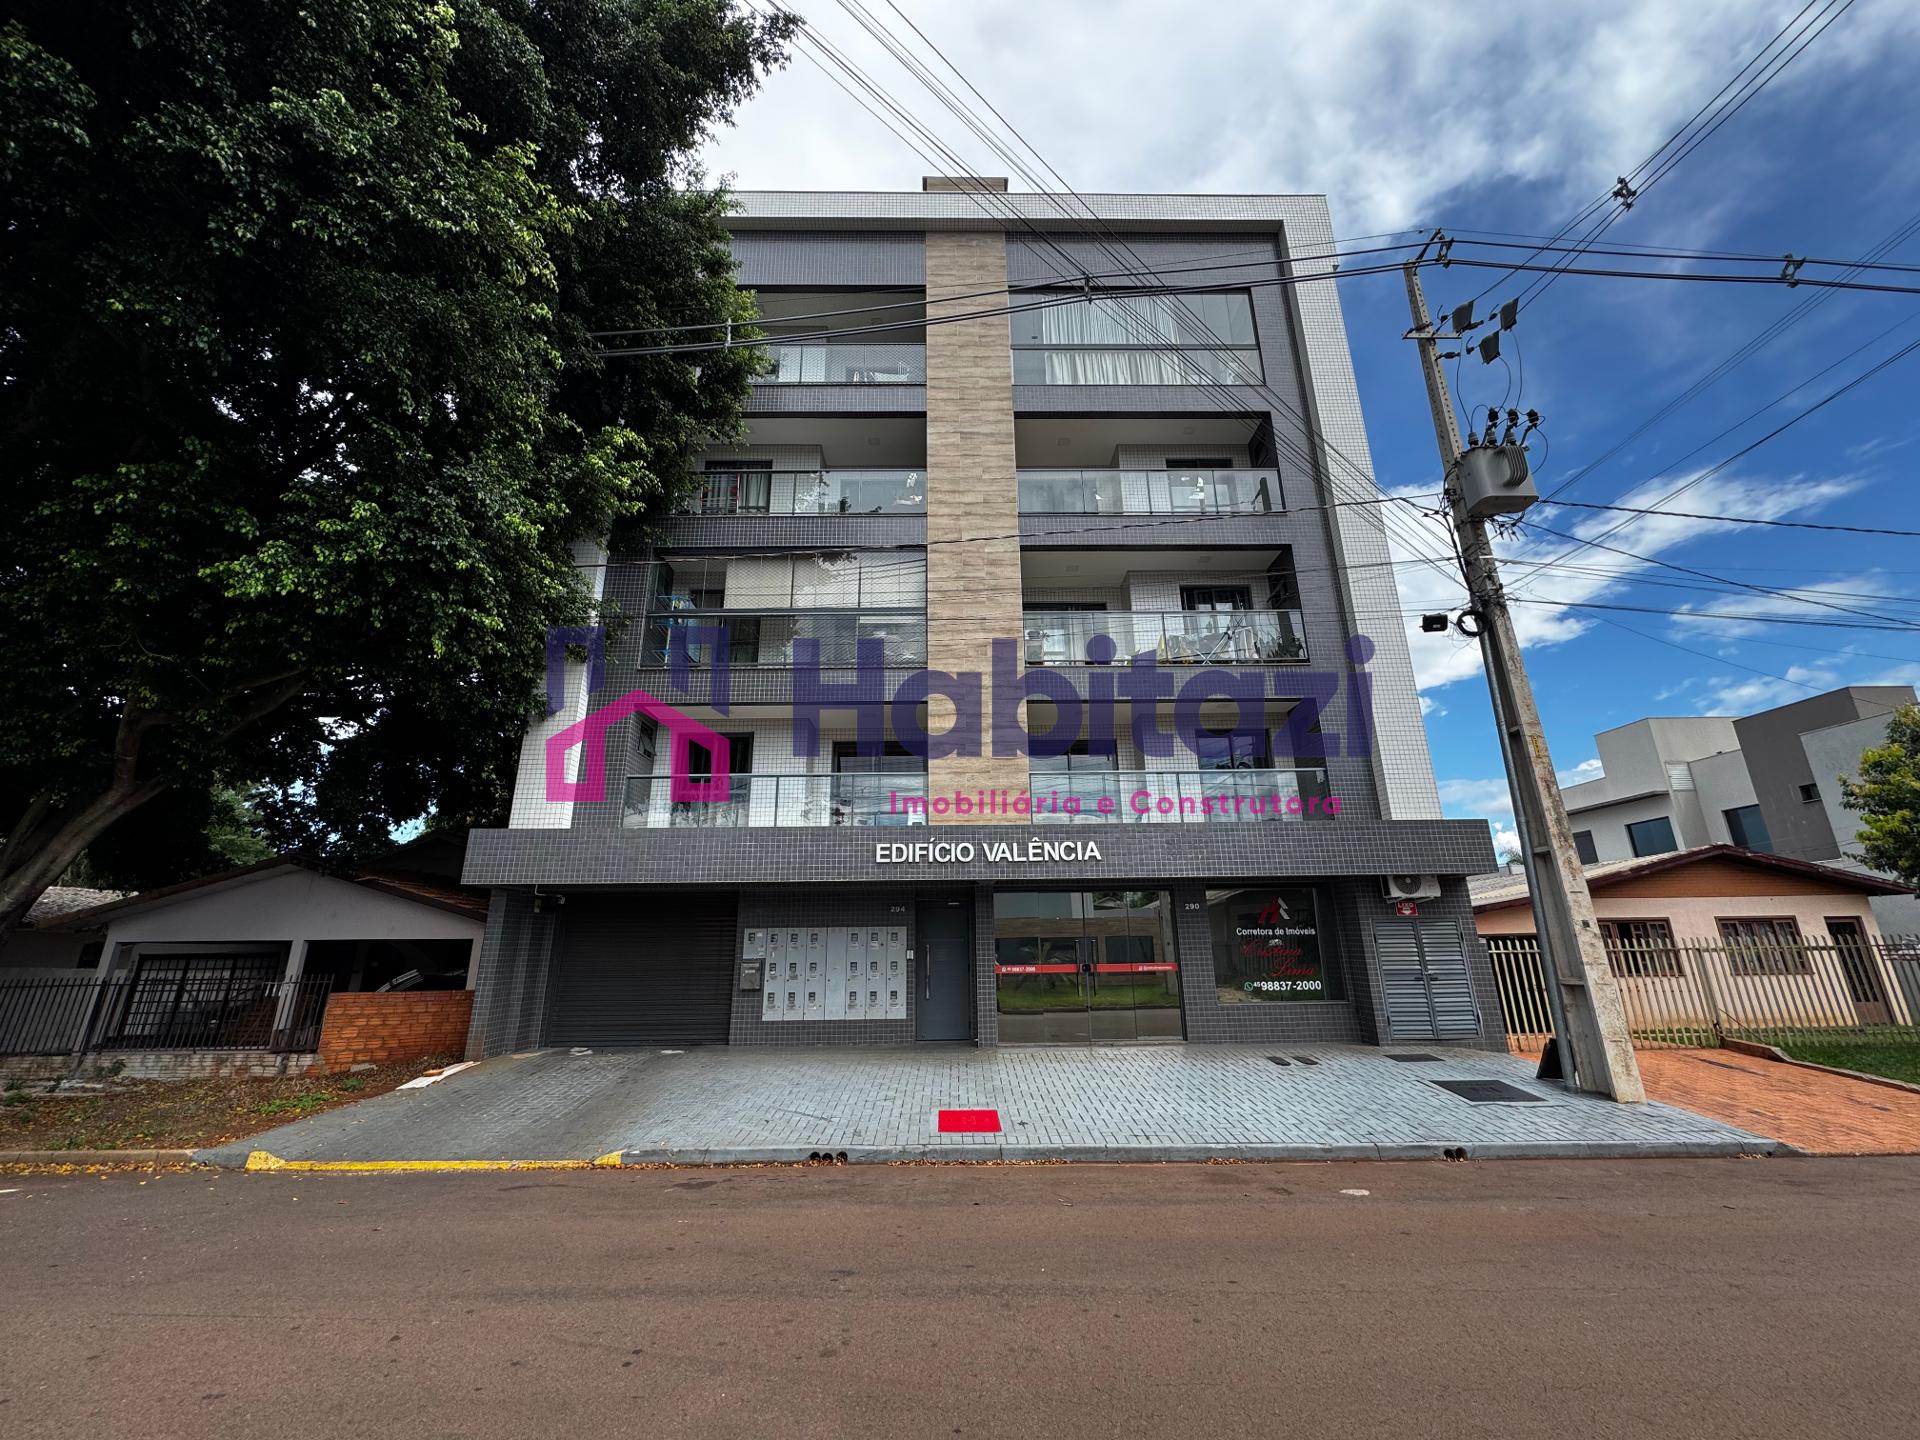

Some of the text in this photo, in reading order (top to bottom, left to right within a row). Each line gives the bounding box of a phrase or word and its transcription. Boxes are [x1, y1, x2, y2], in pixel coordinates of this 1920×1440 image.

[875, 836, 1102, 863] EDIFÍCIO VALÊNCIA
[1236, 925, 1316, 936] Corretora de Imóveis
